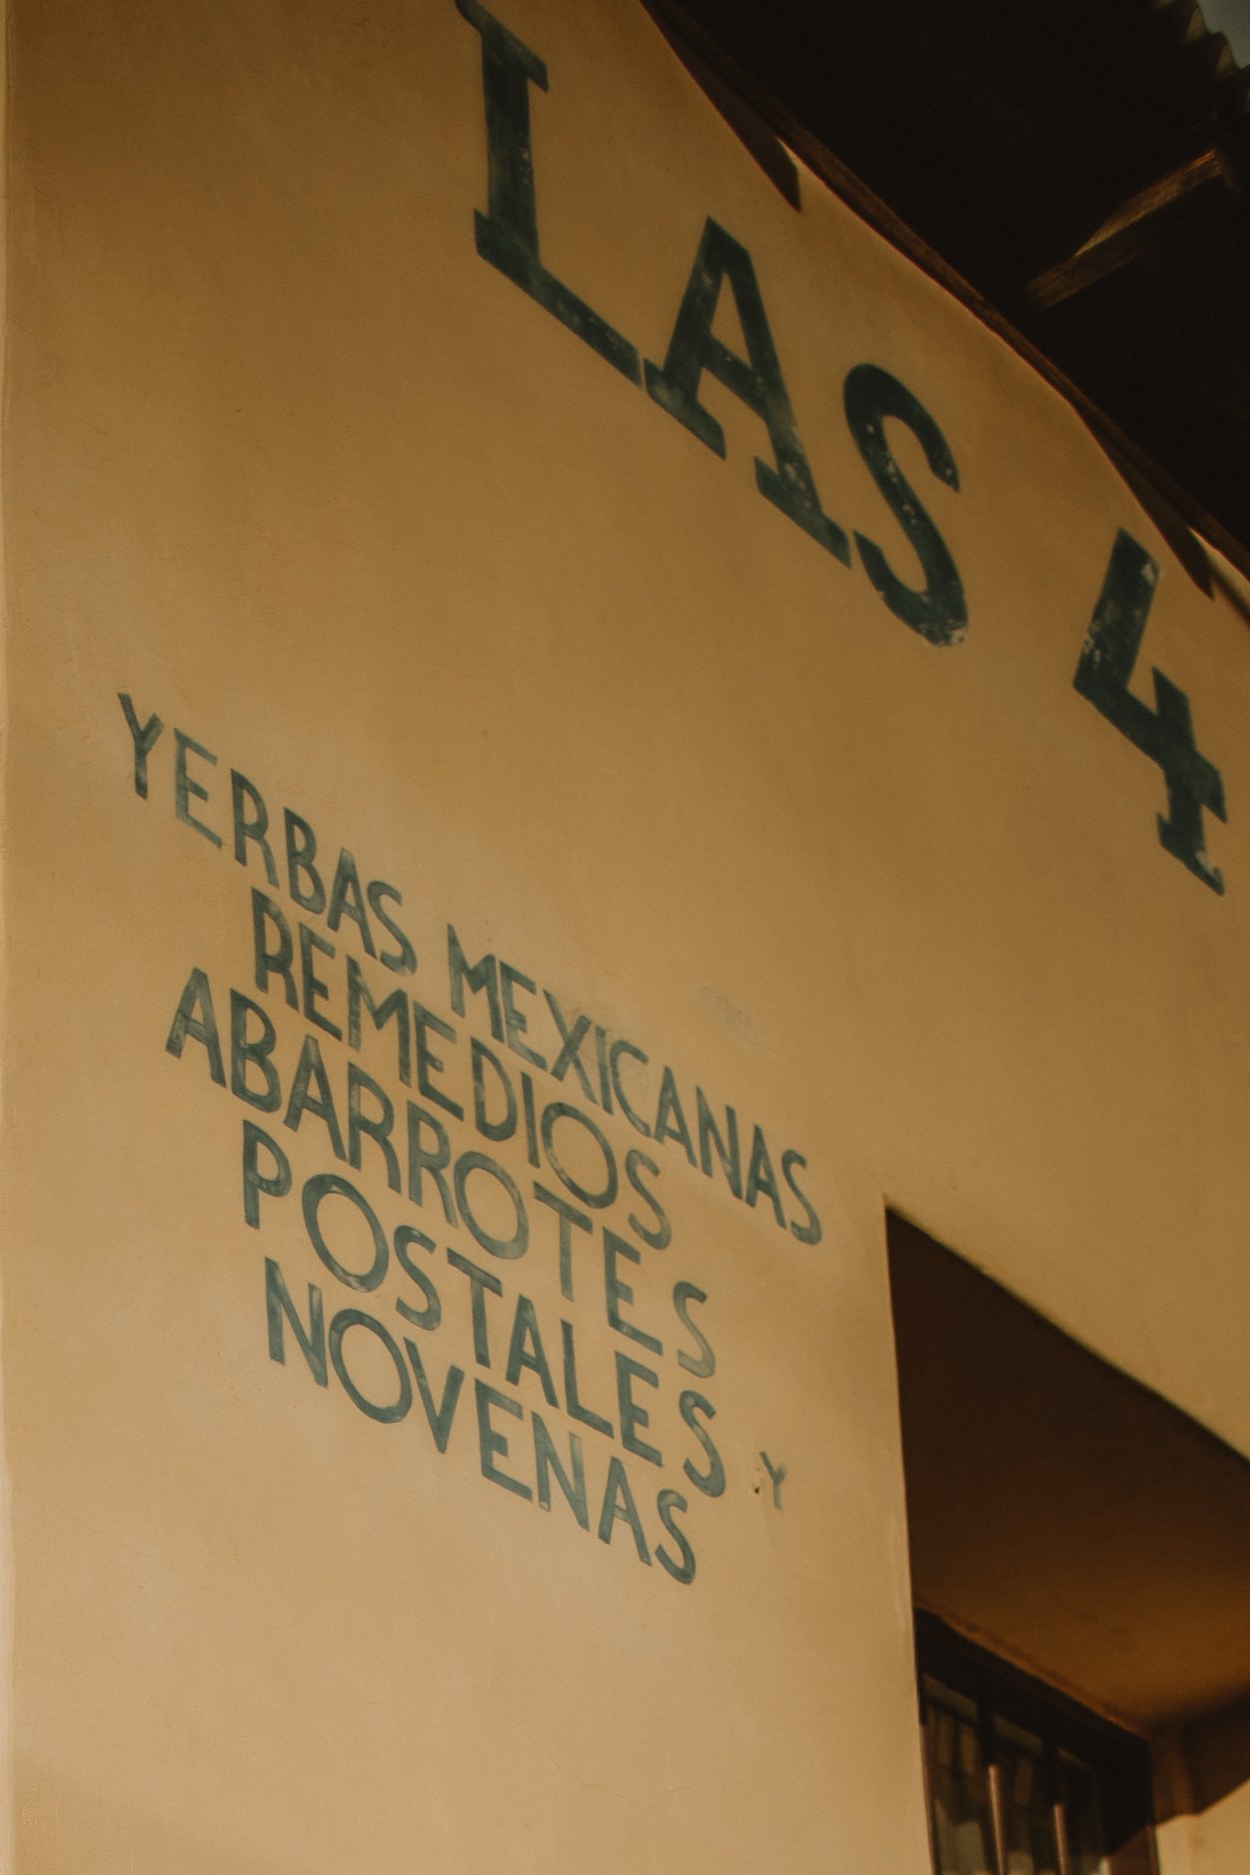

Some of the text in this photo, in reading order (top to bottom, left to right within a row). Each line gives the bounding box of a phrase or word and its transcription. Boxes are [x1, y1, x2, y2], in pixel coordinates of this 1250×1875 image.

[454, 0, 1228, 897] LAS 4
[117, 691, 823, 1247] YERBAS MEXICANAS
[250, 886, 672, 1251] REMEDIOS
[164, 967, 716, 1379] ABARROTES
[242, 1120, 788, 1511] POSTALES Y
[263, 1256, 696, 1586] NOVENAS
